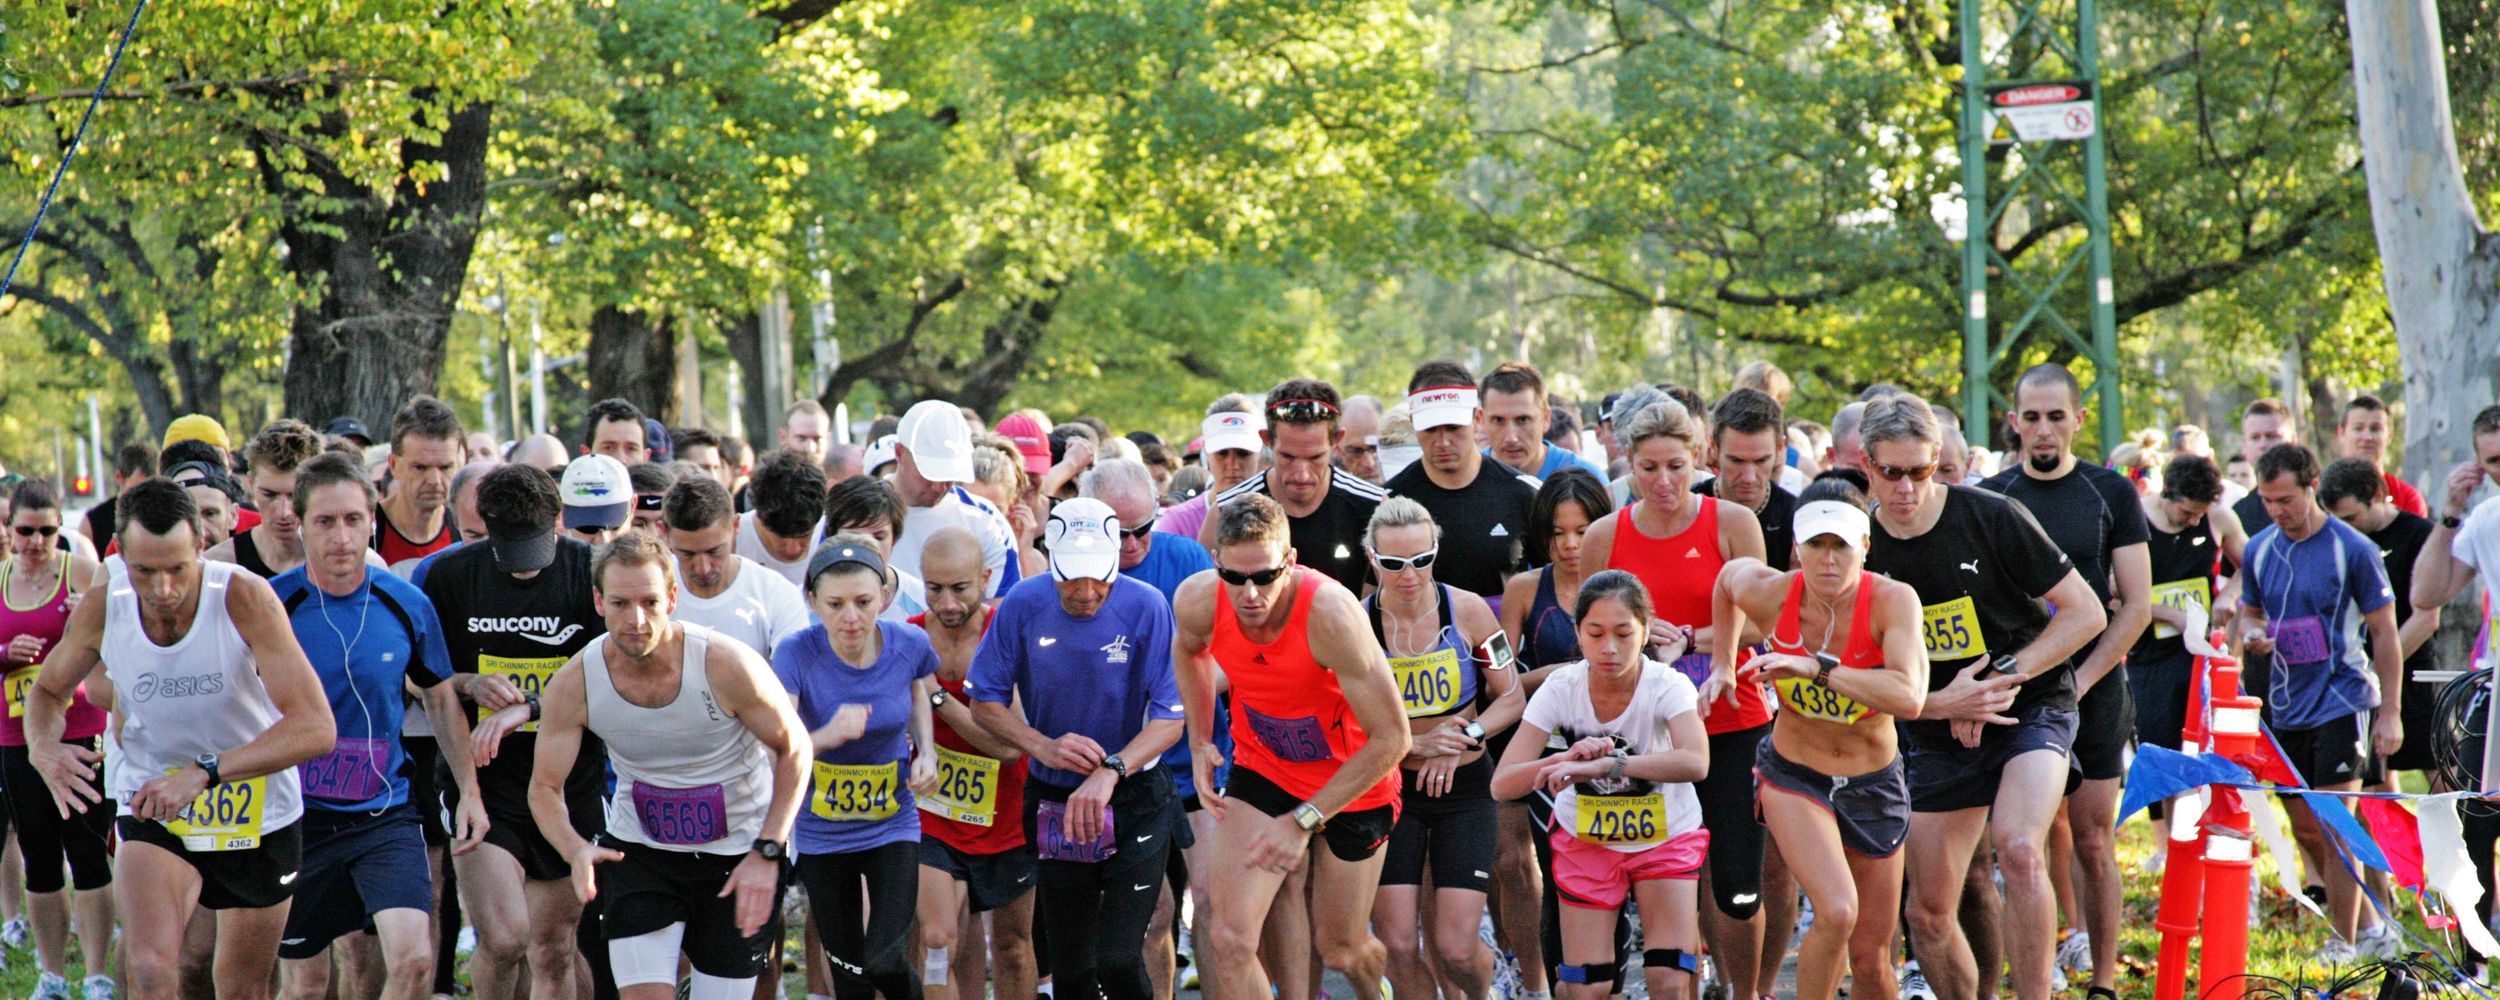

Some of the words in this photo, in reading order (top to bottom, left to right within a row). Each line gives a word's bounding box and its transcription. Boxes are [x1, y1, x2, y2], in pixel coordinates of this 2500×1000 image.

[2007, 86, 2065, 104] DANGER
[1940, 602, 1966, 613] RACES
[467, 616, 560, 635] saucony
[486, 659, 498, 667] SRI
[499, 661, 534, 670] CHINMOY
[536, 661, 562, 670] RACES
[1392, 660, 1425, 669] CHINMOY
[1426, 654, 1450, 664] RACES
[160, 673, 224, 698] asics
[1393, 665, 1451, 707] 406
[702, 691, 719, 720] 2XU
[820, 765, 832, 775] SRI
[833, 768, 869, 777] CHINMOY
[967, 759, 993, 769] RACES
[304, 752, 372, 797] 6471
[937, 762, 986, 804] 265
[824, 778, 888, 812] 4334
[1583, 798, 1594, 807] SRI
[1595, 799, 1630, 808] CHINMOY
[1631, 797, 1658, 806] RACES
[645, 799, 714, 841] 6569
[960, 814, 985, 824] 4265
[1588, 808, 1655, 841] 4266
[227, 839, 252, 848] 4362
